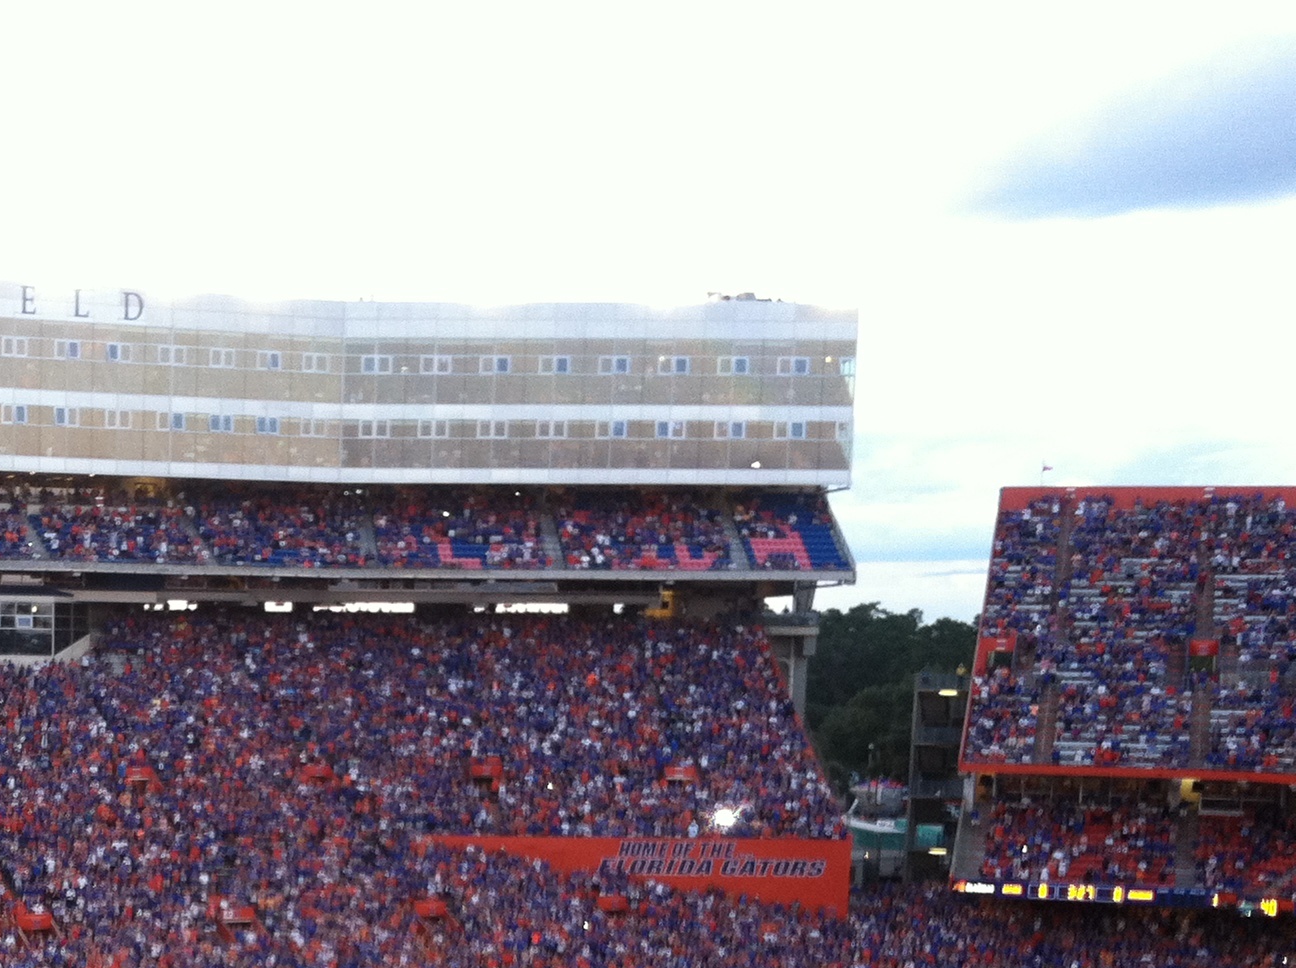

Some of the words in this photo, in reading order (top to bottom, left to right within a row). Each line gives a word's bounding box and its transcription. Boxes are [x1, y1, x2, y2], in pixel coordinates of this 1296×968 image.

[618, 841, 670, 859] HOME
[672, 841, 696, 859] OF
[699, 841, 737, 859] THE
[719, 858, 827, 878] GATORS
